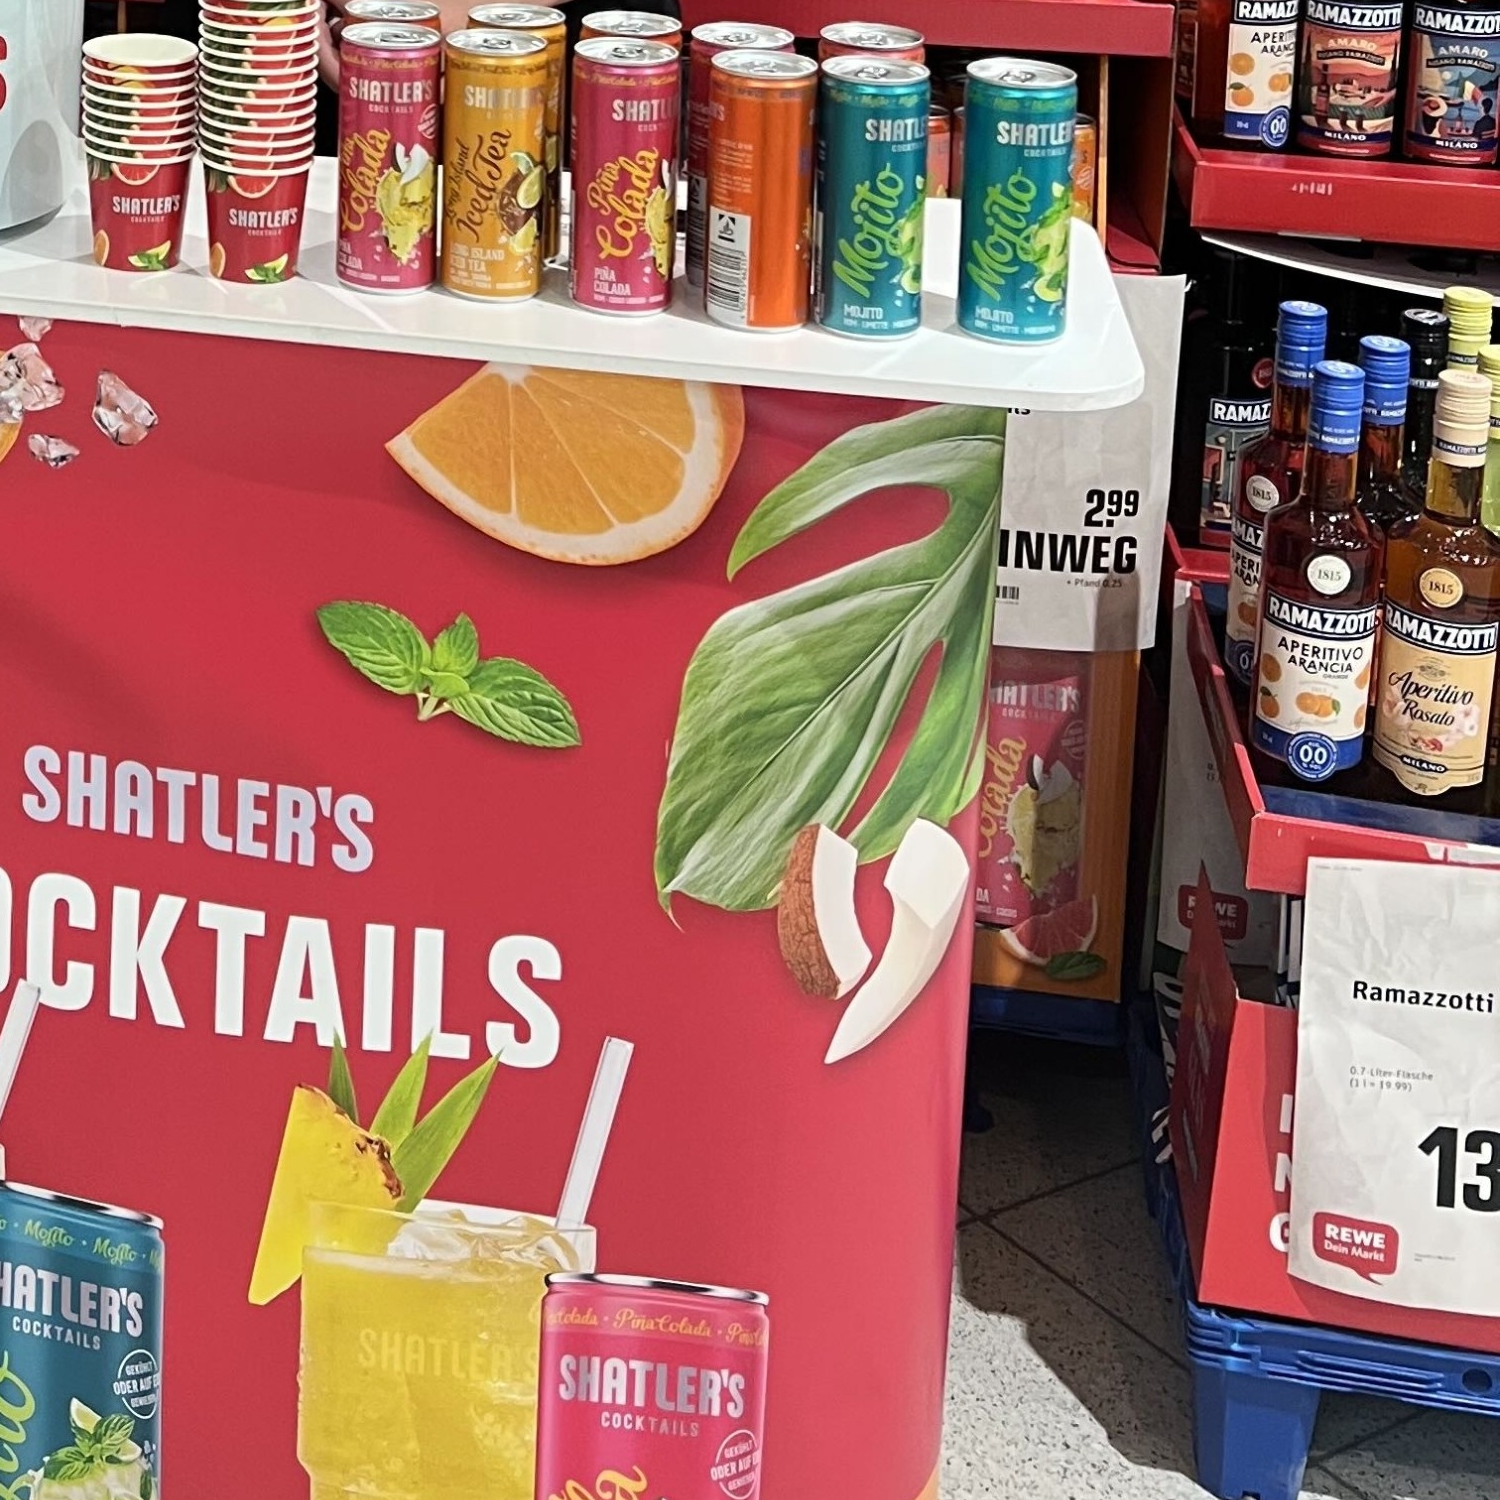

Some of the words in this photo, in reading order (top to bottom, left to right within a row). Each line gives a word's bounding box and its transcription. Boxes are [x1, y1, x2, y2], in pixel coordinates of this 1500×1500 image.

[1328, 37, 1377, 51] AMARO
[1438, 45, 1489, 58] AMARO
[349, 76, 434, 104] SHATLER'S
[1324, 130, 1367, 142] MILANO
[1435, 139, 1478, 149] MILANO
[472, 127, 511, 182] Tea
[340, 126, 392, 234] Colada
[112, 194, 181, 214] SHATLER'S
[597, 145, 660, 260] Colada
[229, 207, 299, 228] SHATLER'S
[831, 161, 906, 299] Mojito
[966, 166, 1039, 301] Mojito
[593, 280, 632, 297] COLADA
[1084, 488, 1140, 528] 2.99
[998, 529, 1138, 575] INWEG
[1317, 568, 1342, 582] 1815
[1429, 580, 1454, 595] 1815
[1269, 596, 1376, 634] RAMAZZOTTI
[1386, 606, 1496, 649] RAMAZZOTTI
[1278, 636, 1363, 661] APERITIVO
[1287, 654, 1353, 675] ARANCIA
[1388, 671, 1474, 706] Aperitivo
[1401, 698, 1455, 727] Rosato
[1402, 755, 1446, 772] MILANO
[21, 744, 374, 873] SHATLER'S
[1352, 980, 1494, 1014] Ramazzotti
[1324, 1223, 1386, 1249] REWE
[1324, 1241, 1349, 1256] Dein
[1350, 1244, 1386, 1263] Markt
[12, 1315, 101, 1351] COCKTAILS
[113, 1378, 138, 1396] ODER
[559, 1353, 745, 1418] SHATLER'S
[601, 1411, 699, 1438] COCKTAILS
[710, 1459, 736, 1481] ODER
